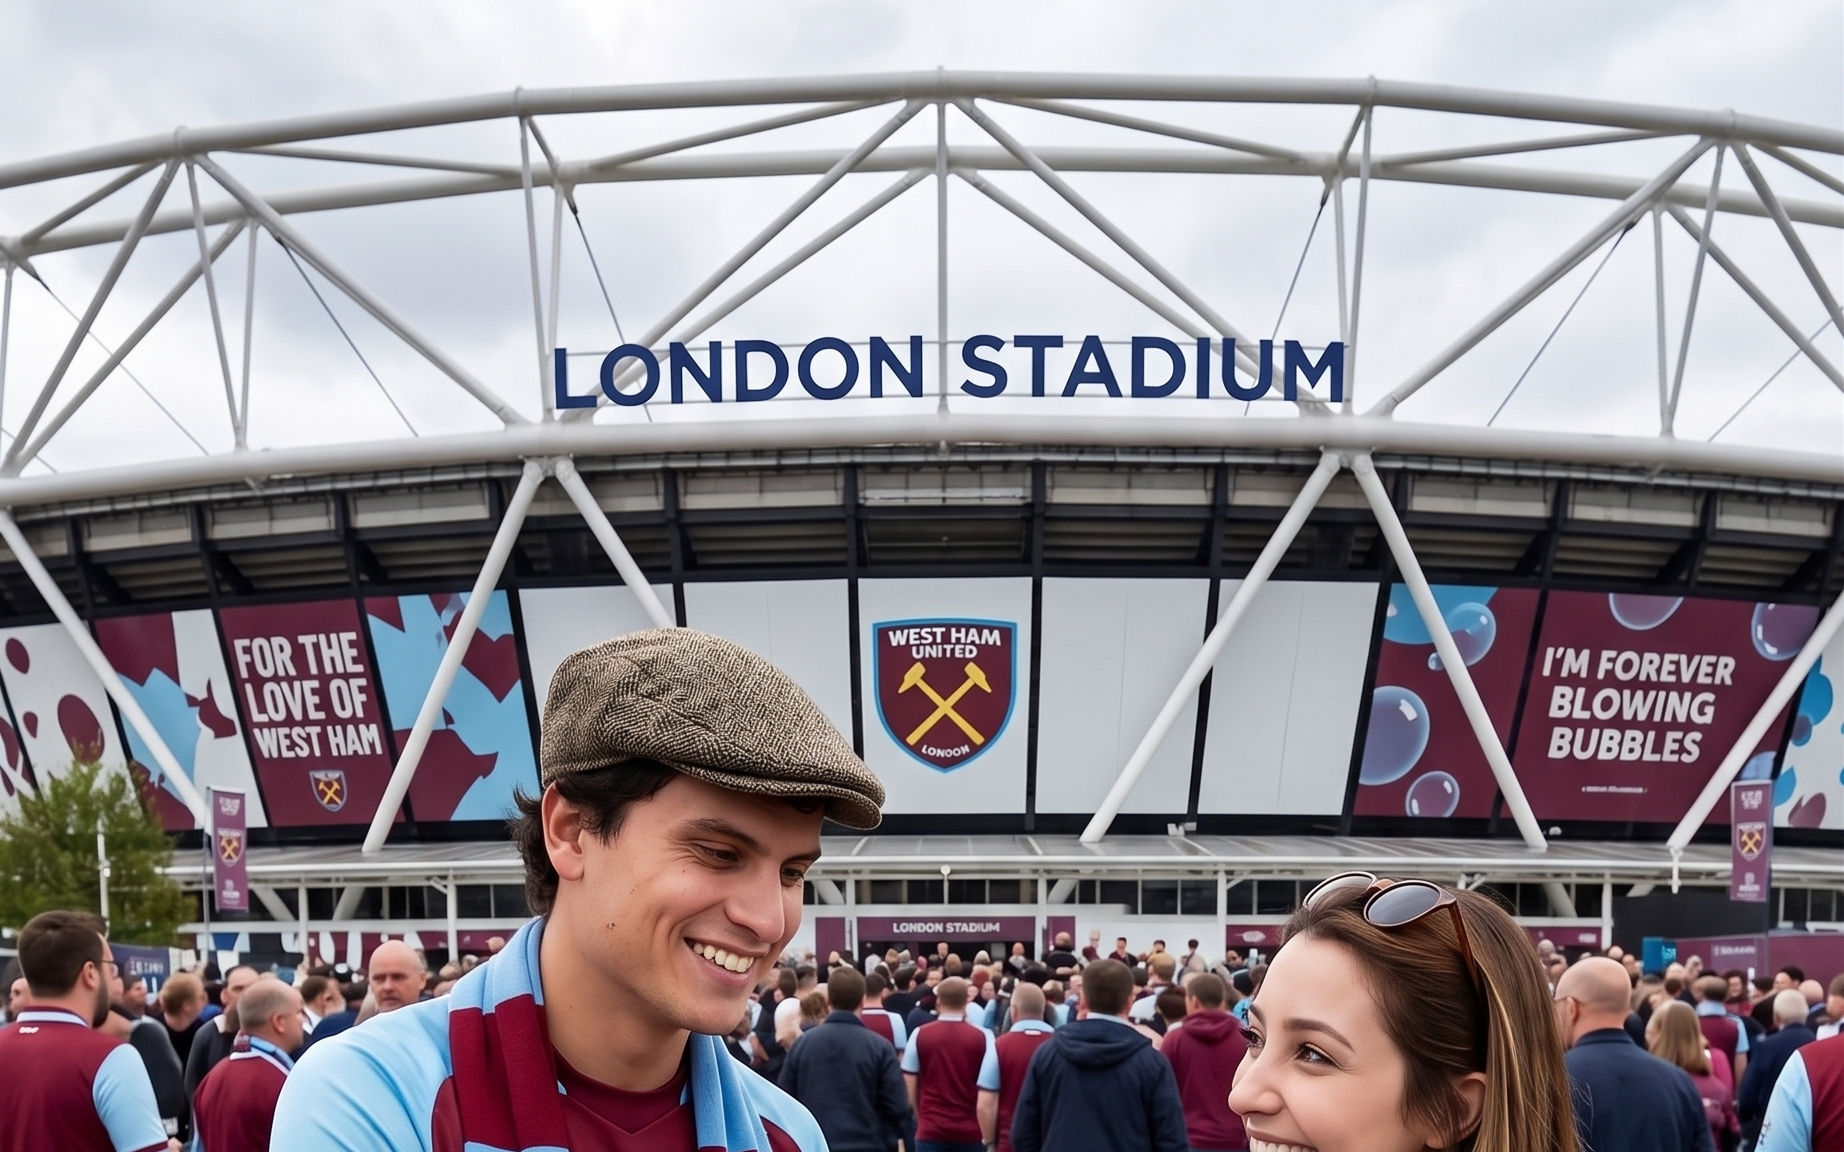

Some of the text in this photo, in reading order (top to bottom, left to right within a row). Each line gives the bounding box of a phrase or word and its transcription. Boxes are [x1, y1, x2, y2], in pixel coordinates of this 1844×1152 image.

[553, 335, 1346, 409] LONDON STADIUM
[233, 631, 364, 679] FOR THE
[888, 627, 1001, 647] WEST HAM
[911, 644, 978, 659] UNITED
[1542, 646, 1736, 686] I'M FOREVER
[245, 678, 368, 723] LOVE OF
[1548, 685, 1716, 725] BLOWING
[253, 723, 382, 759] WEST HAM
[1547, 726, 1702, 763] BUBBLES
[892, 922, 1000, 933] LONDON STADIUM
